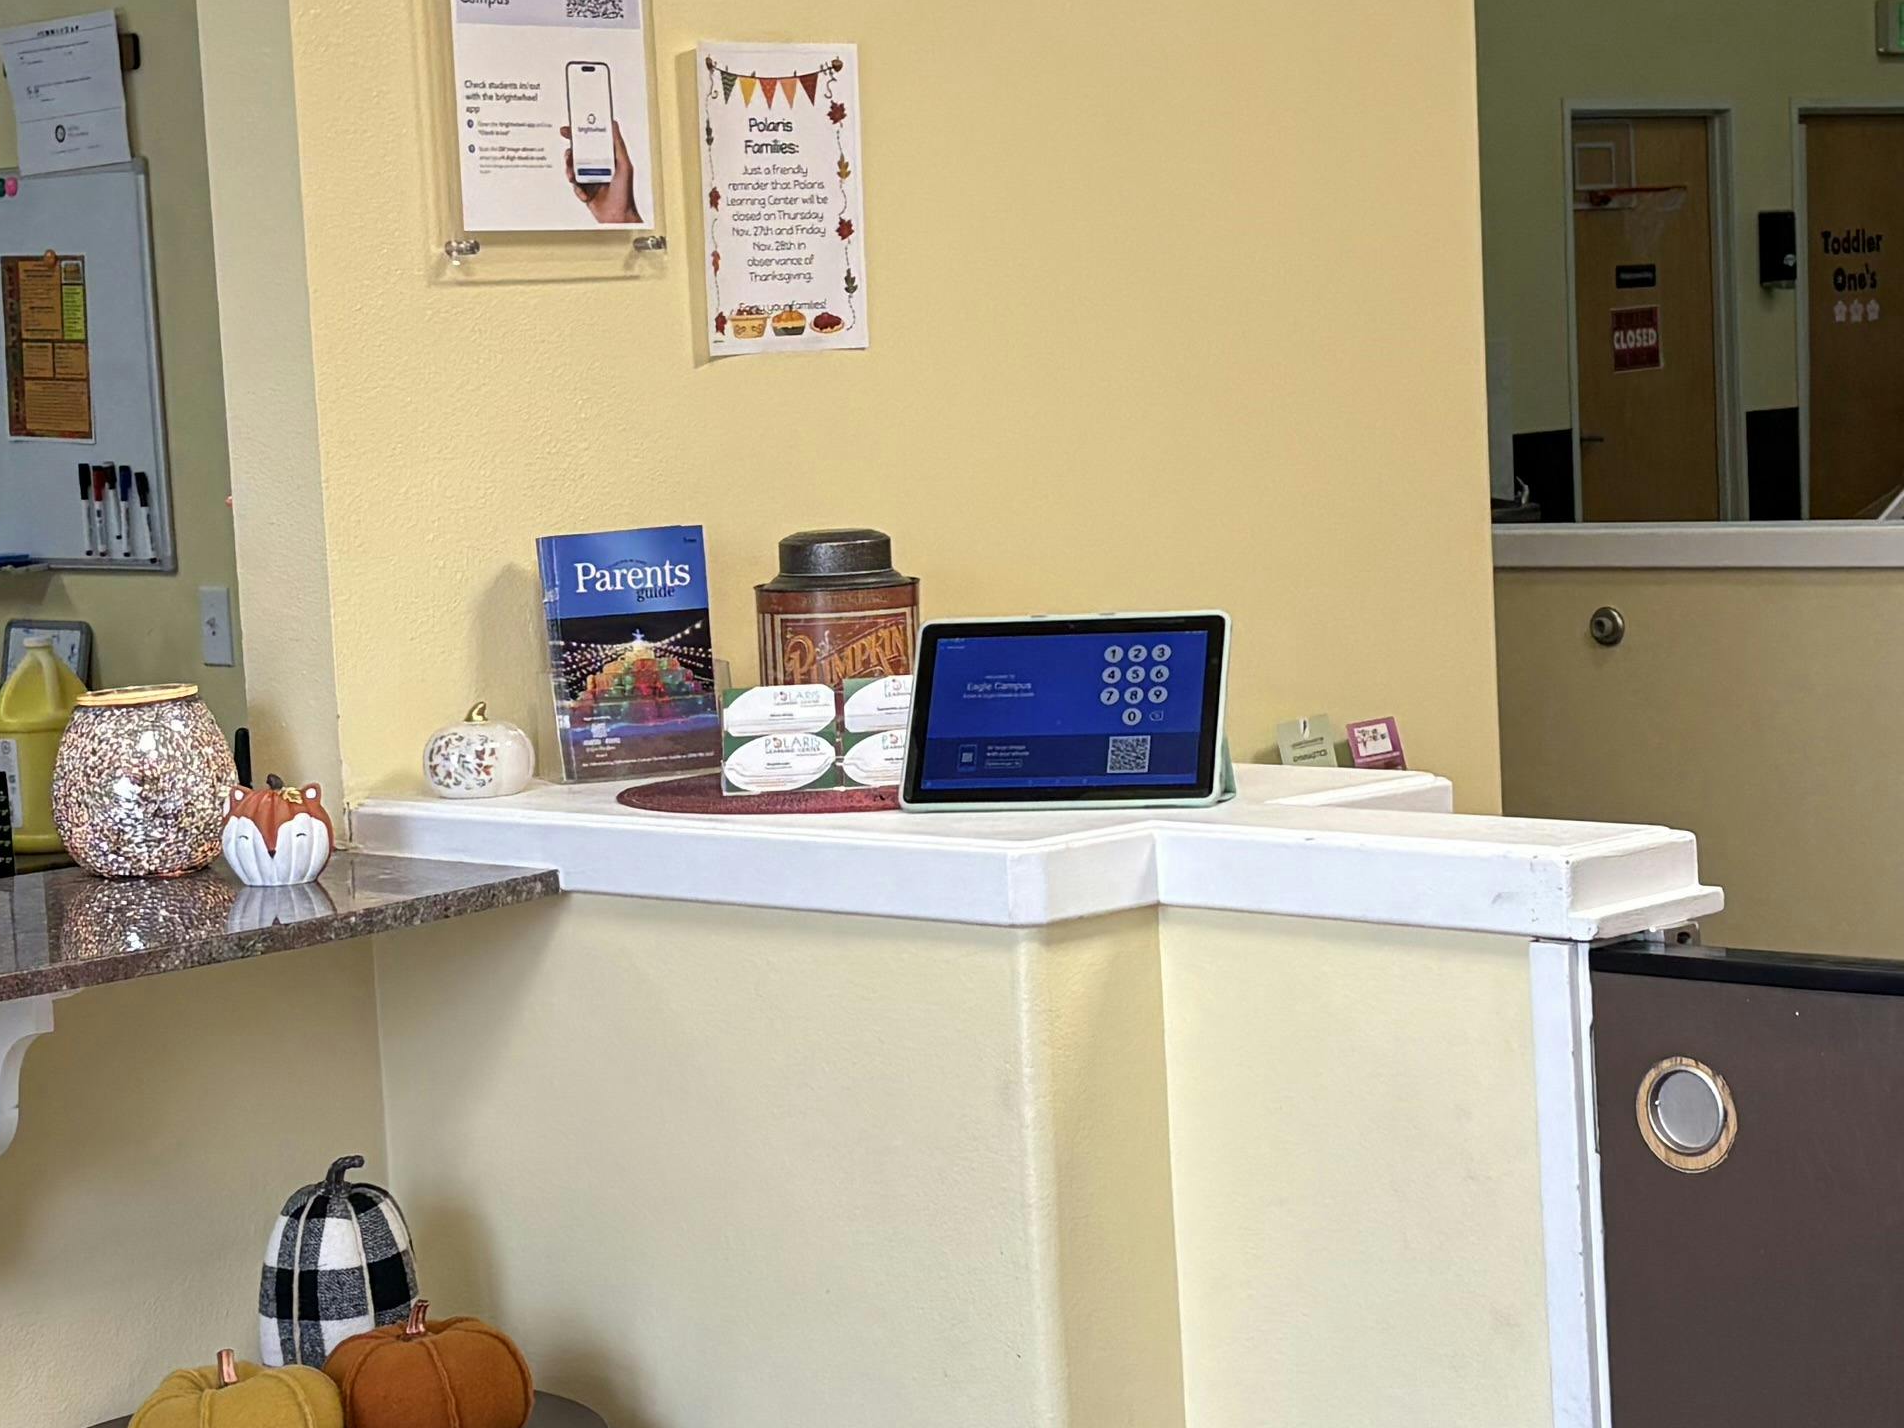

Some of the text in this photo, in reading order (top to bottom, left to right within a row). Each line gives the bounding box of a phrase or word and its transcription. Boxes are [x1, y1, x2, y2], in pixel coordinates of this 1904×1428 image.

[464, 80, 487, 89] Check
[488, 81, 518, 90] students
[482, 93, 494, 101] the
[748, 117, 793, 132] Polaris
[744, 139, 800, 154] Families:
[742, 164, 808, 178] Just a friendly
[728, 179, 825, 191] reminder that Polaris
[726, 195, 766, 209] Learning
[767, 195, 800, 206] Center
[816, 194, 828, 204] be
[763, 212, 776, 221] on
[777, 210, 824, 222] Thursday
[775, 226, 794, 235] and
[795, 224, 827, 237] Friday
[796, 241, 806, 250] in
[1820, 228, 1884, 255] Toddler
[747, 254, 815, 267] observance of
[1833, 263, 1877, 292] One's
[1613, 327, 1657, 350] CLOSED
[574, 559, 691, 594] Parents
[636, 585, 676, 603] guide
[784, 624, 905, 686] PUMPKIN
[1110, 647, 1165, 659] 1 2 3
[1107, 668, 1164, 680] 4 5 6
[773, 690, 821, 702] POLARIS
[1106, 689, 1162, 702] 7 8 9
[1127, 711, 1136, 722] 0
[764, 737, 821, 749] POLARIS
